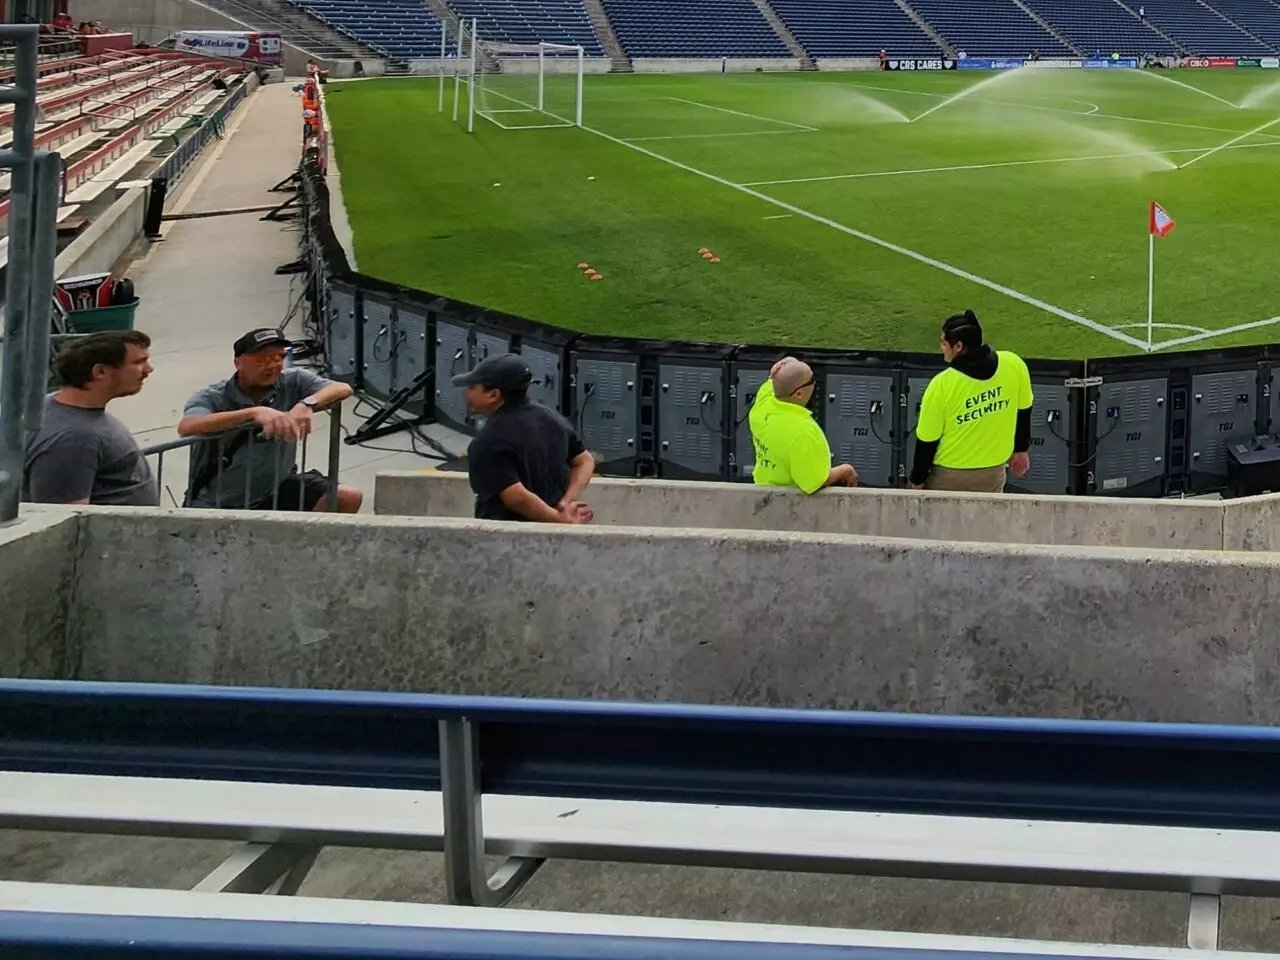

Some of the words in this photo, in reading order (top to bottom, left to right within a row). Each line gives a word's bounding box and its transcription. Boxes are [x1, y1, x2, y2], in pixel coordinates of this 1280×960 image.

[900, 60, 915, 70] CRS
[917, 60, 942, 70] CARES
[965, 386, 1002, 408] EVENT
[956, 399, 1011, 425] SECURITY
[686, 417, 700, 425] TGI
[853, 427, 869, 436] TGI
[1218, 422, 1234, 431] TGI
[1126, 432, 1141, 442] TGI
